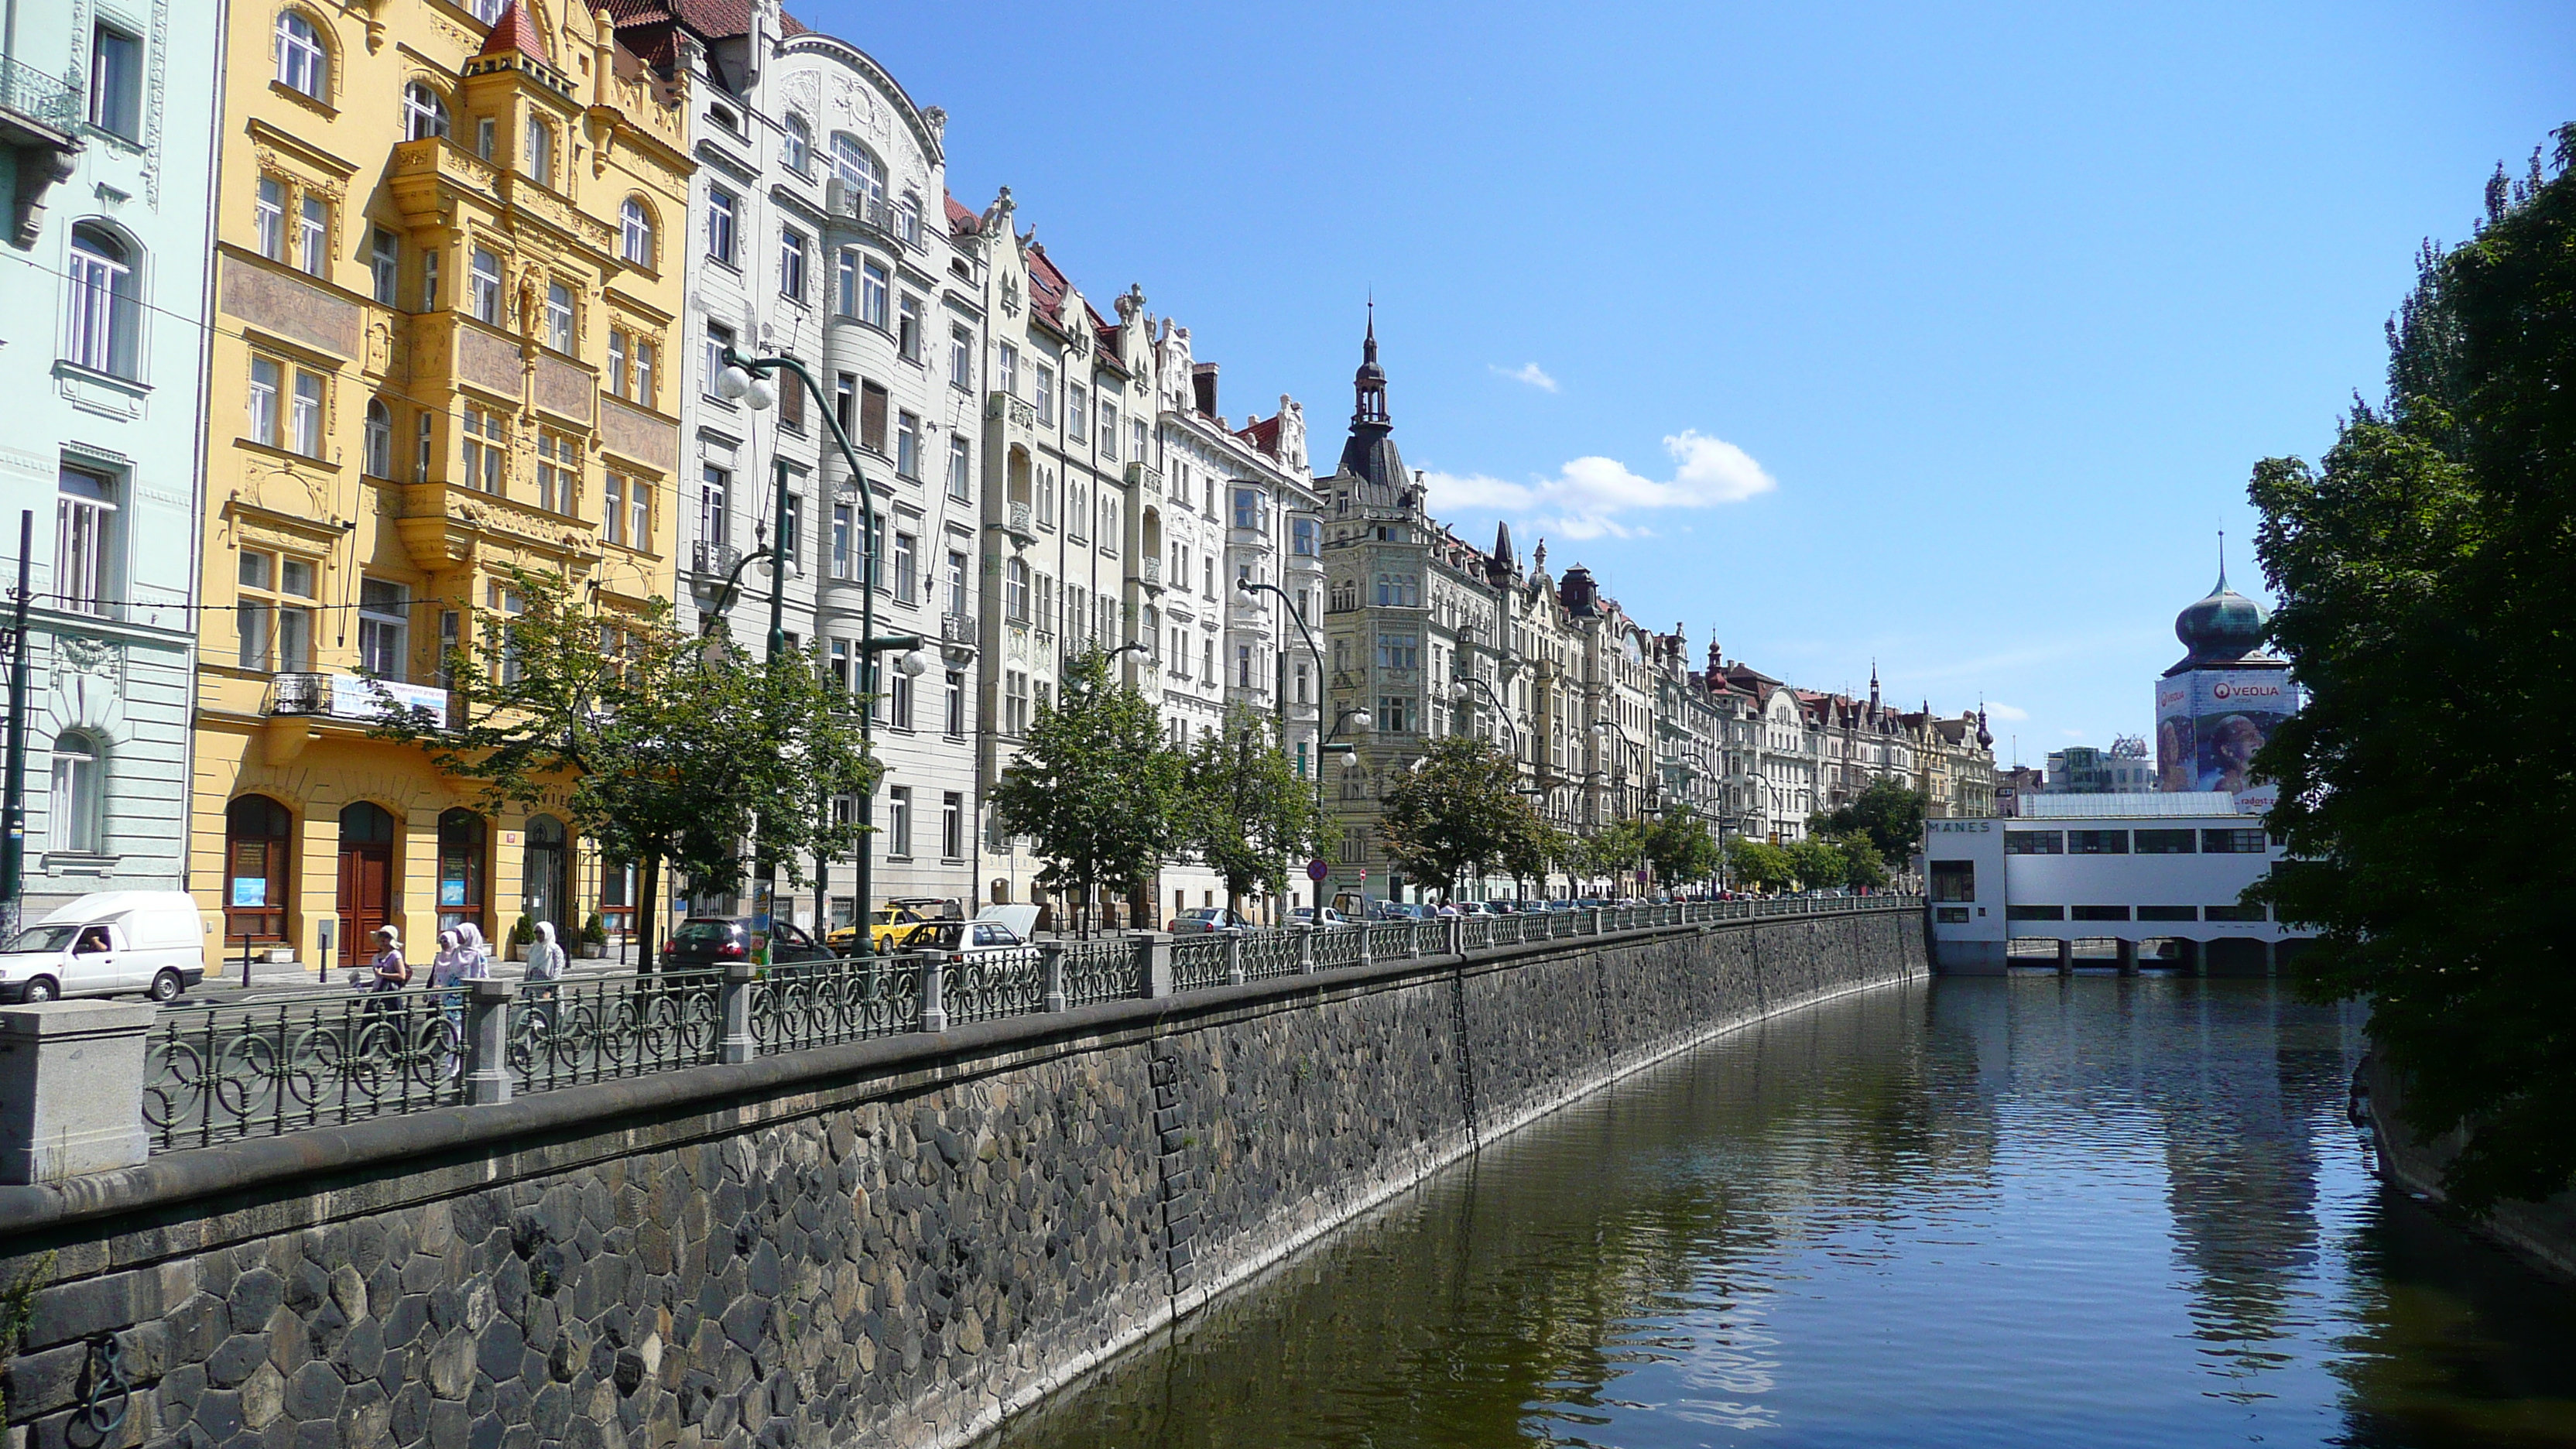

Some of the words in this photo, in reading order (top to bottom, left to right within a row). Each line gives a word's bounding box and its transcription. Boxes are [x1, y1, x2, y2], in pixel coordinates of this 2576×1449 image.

[2232, 687, 2280, 696] VEOLIA
[2168, 690, 2184, 703] VEOLIA
[2241, 796, 2267, 805] radost
